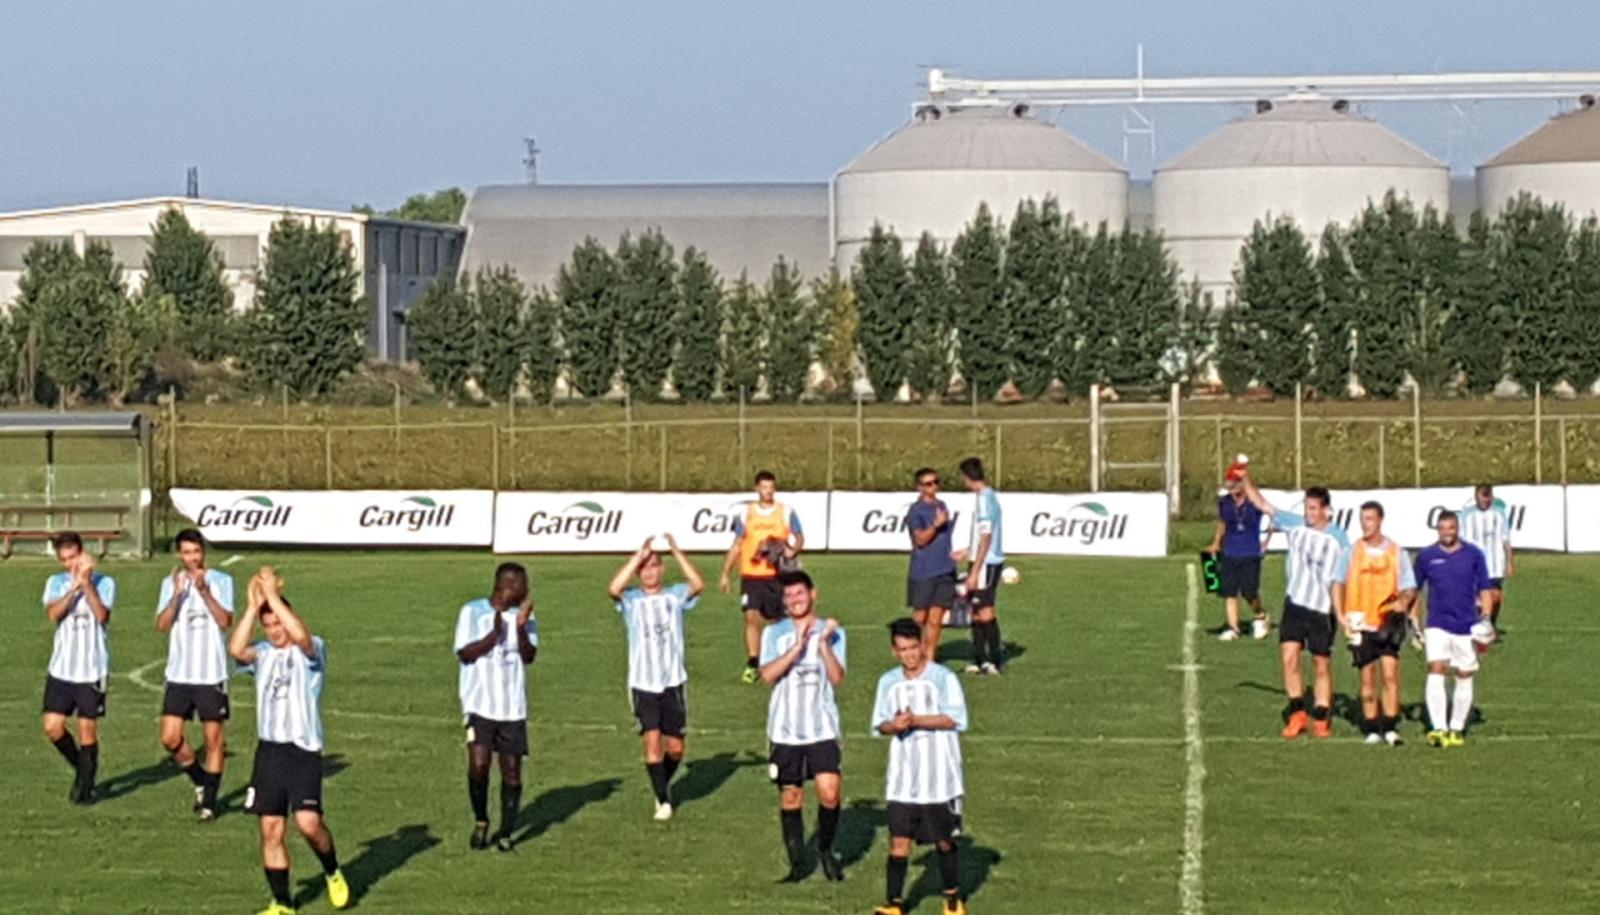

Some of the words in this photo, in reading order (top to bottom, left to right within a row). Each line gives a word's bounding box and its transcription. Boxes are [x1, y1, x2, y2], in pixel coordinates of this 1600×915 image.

[197, 505, 292, 531] Cargill
[359, 504, 454, 530] Cargill
[527, 510, 622, 538] Cargill
[1030, 512, 1128, 544] Cargill
